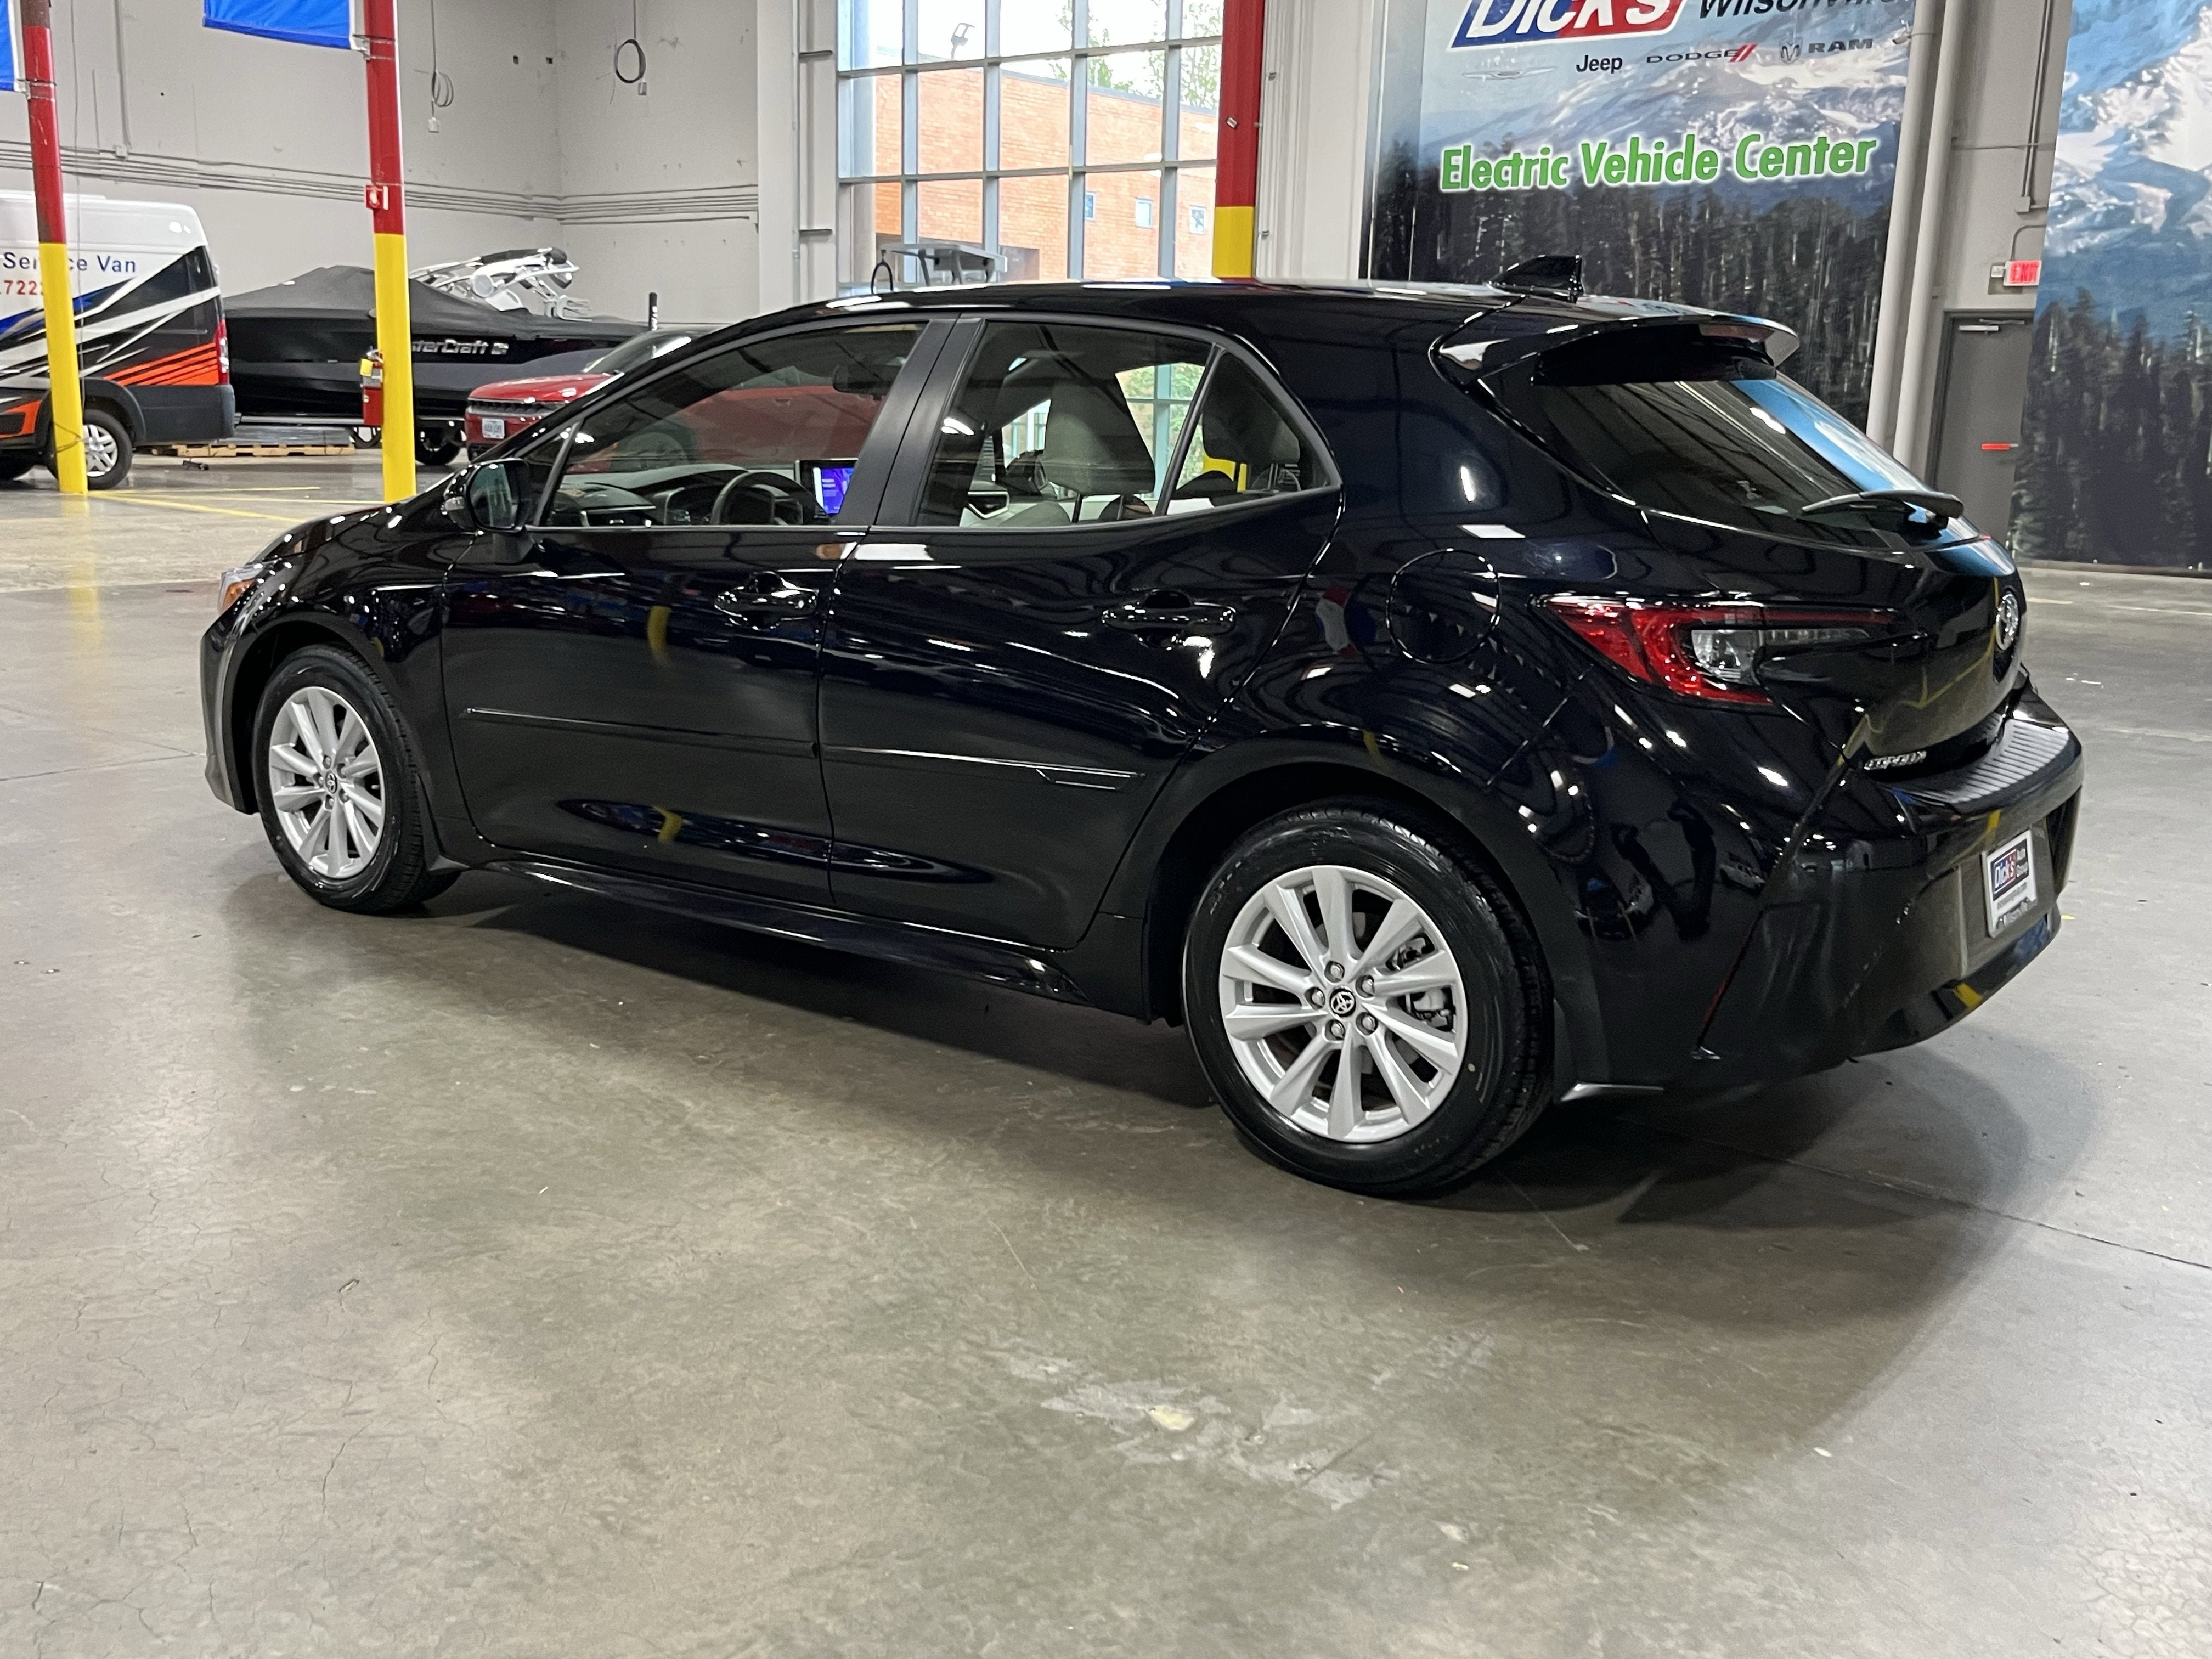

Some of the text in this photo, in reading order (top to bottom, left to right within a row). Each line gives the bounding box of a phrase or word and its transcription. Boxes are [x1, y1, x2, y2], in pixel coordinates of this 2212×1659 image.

[1576, 38, 1874, 74] Jeep DODGE RAM
[1441, 133, 1877, 189] Electric Vehicle Center
[97, 255, 136, 273] Van
[2010, 262, 2039, 282] EXIT
